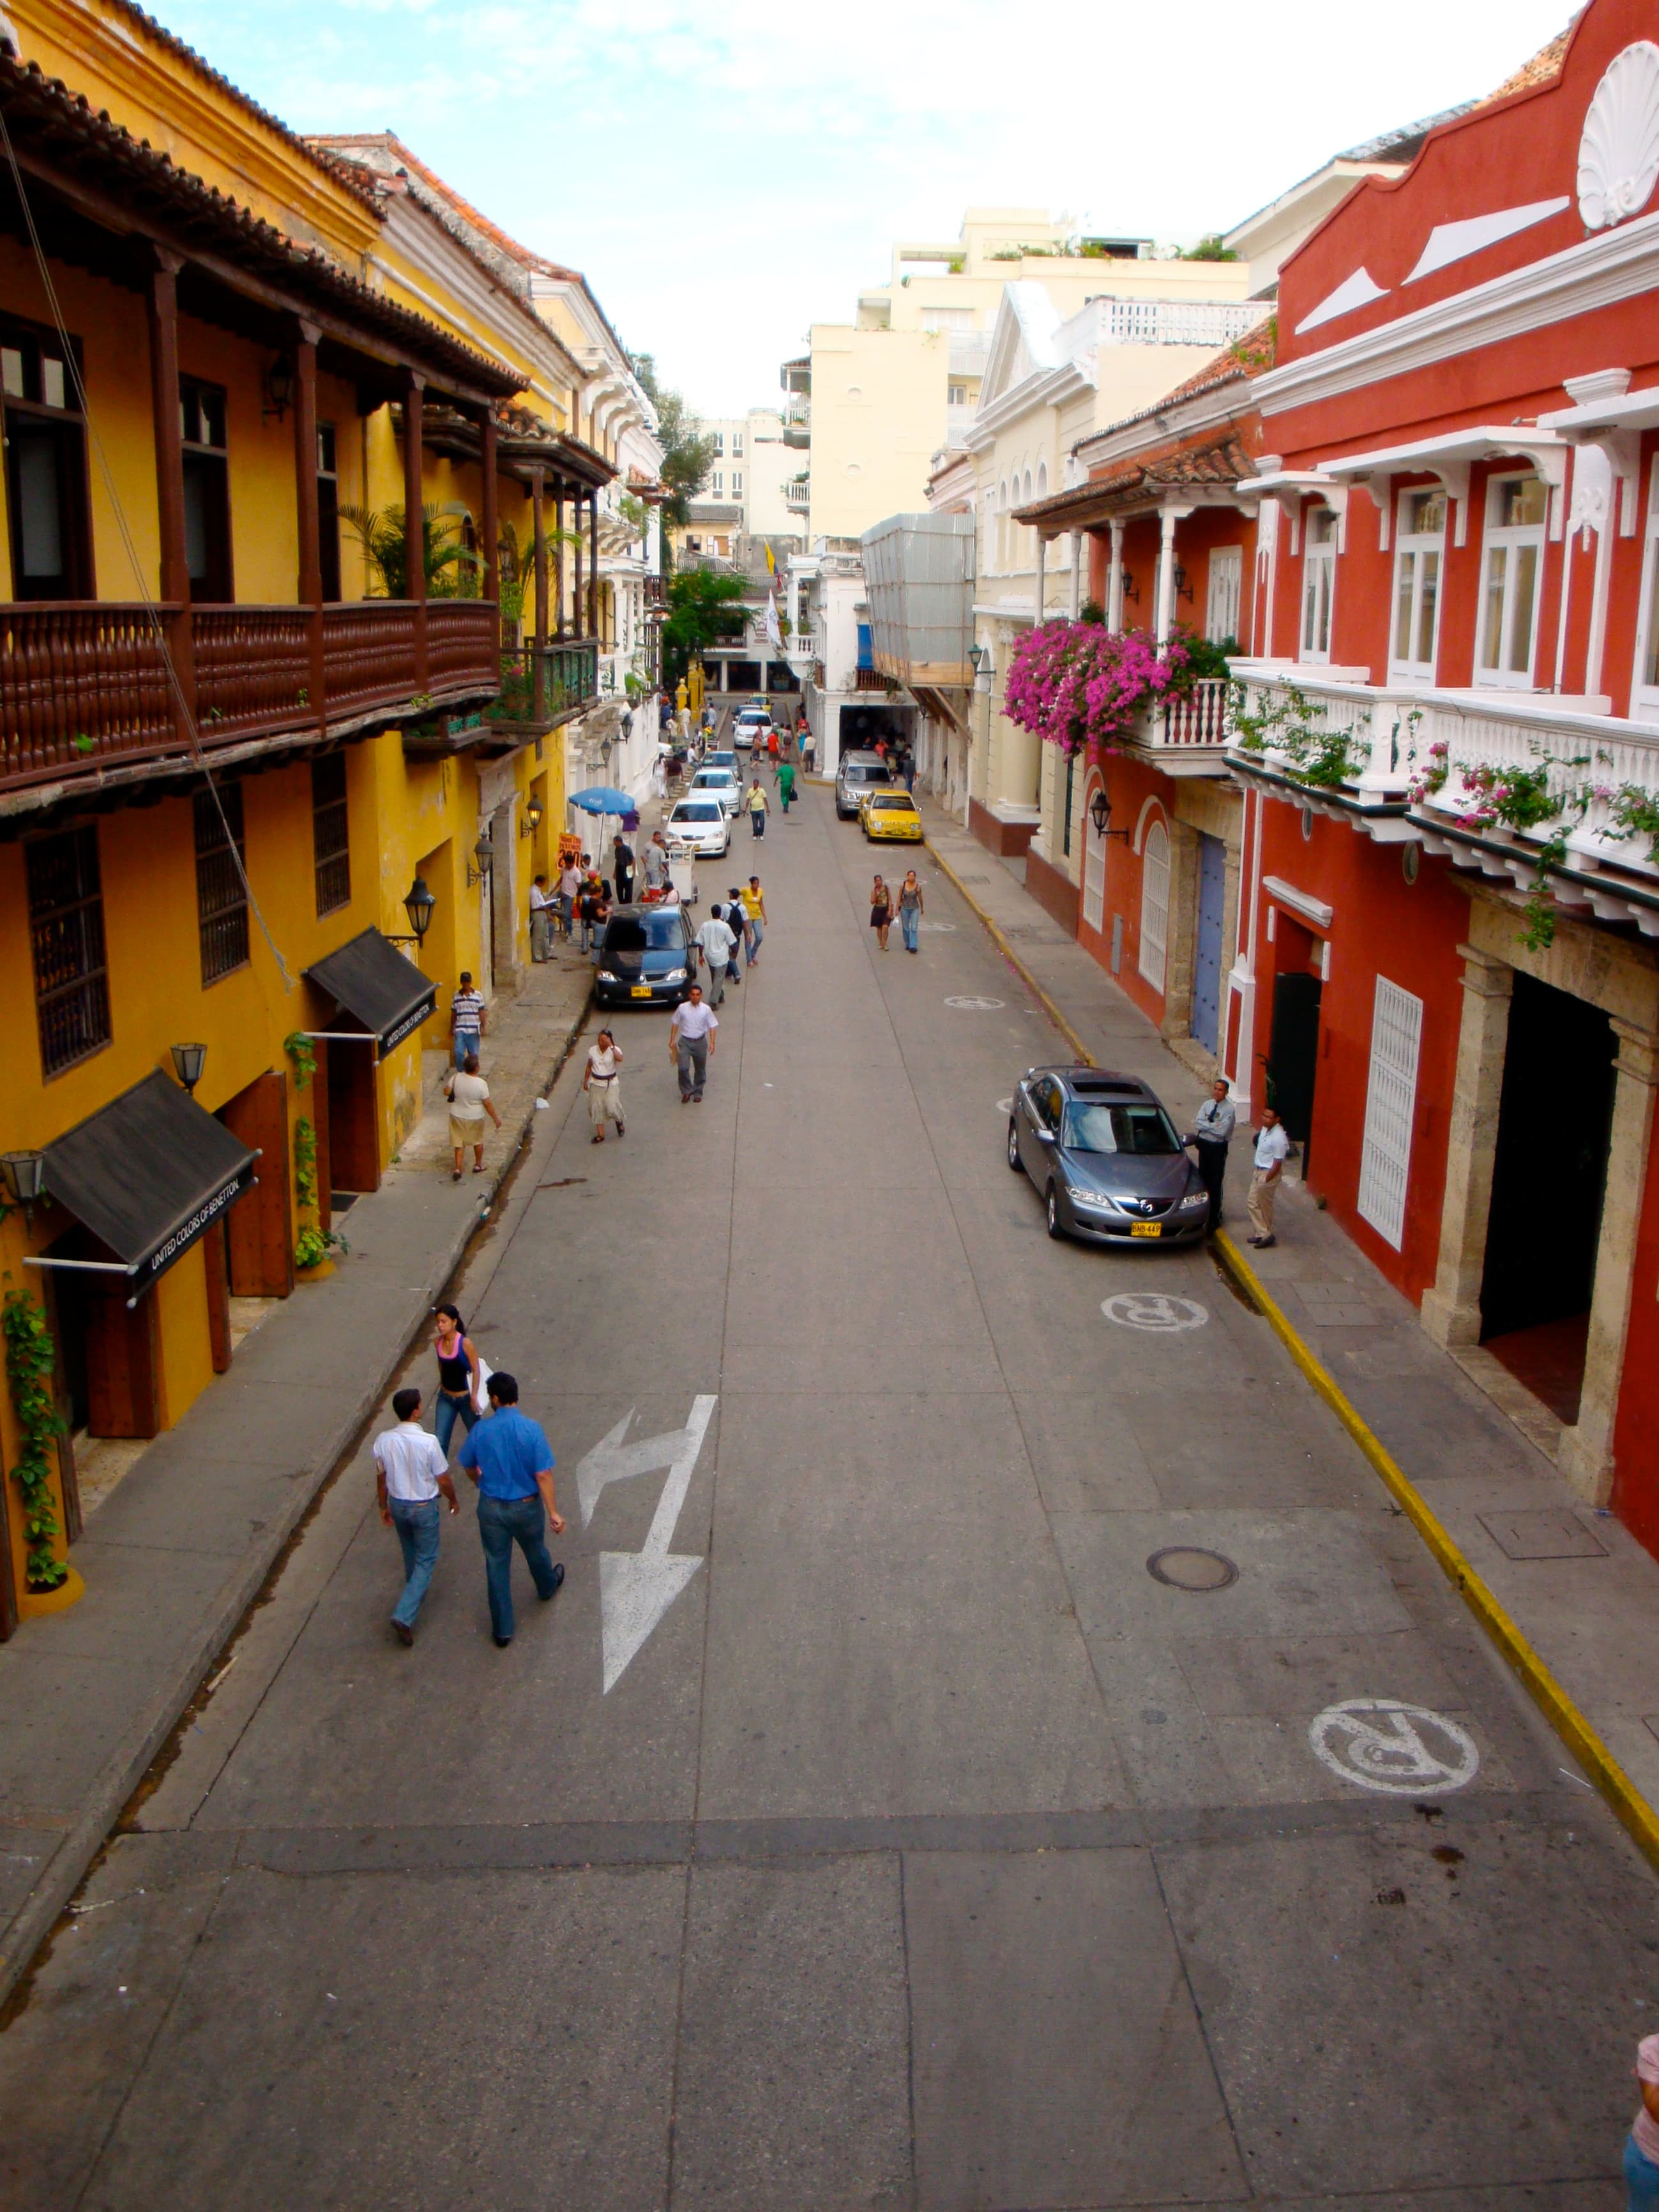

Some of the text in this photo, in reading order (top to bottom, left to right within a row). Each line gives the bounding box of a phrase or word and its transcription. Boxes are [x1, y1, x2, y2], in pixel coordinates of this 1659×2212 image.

[151, 1238, 177, 1270] UNITED
[176, 1214, 201, 1245] COLORS
[200, 1206, 209, 1223] OF
